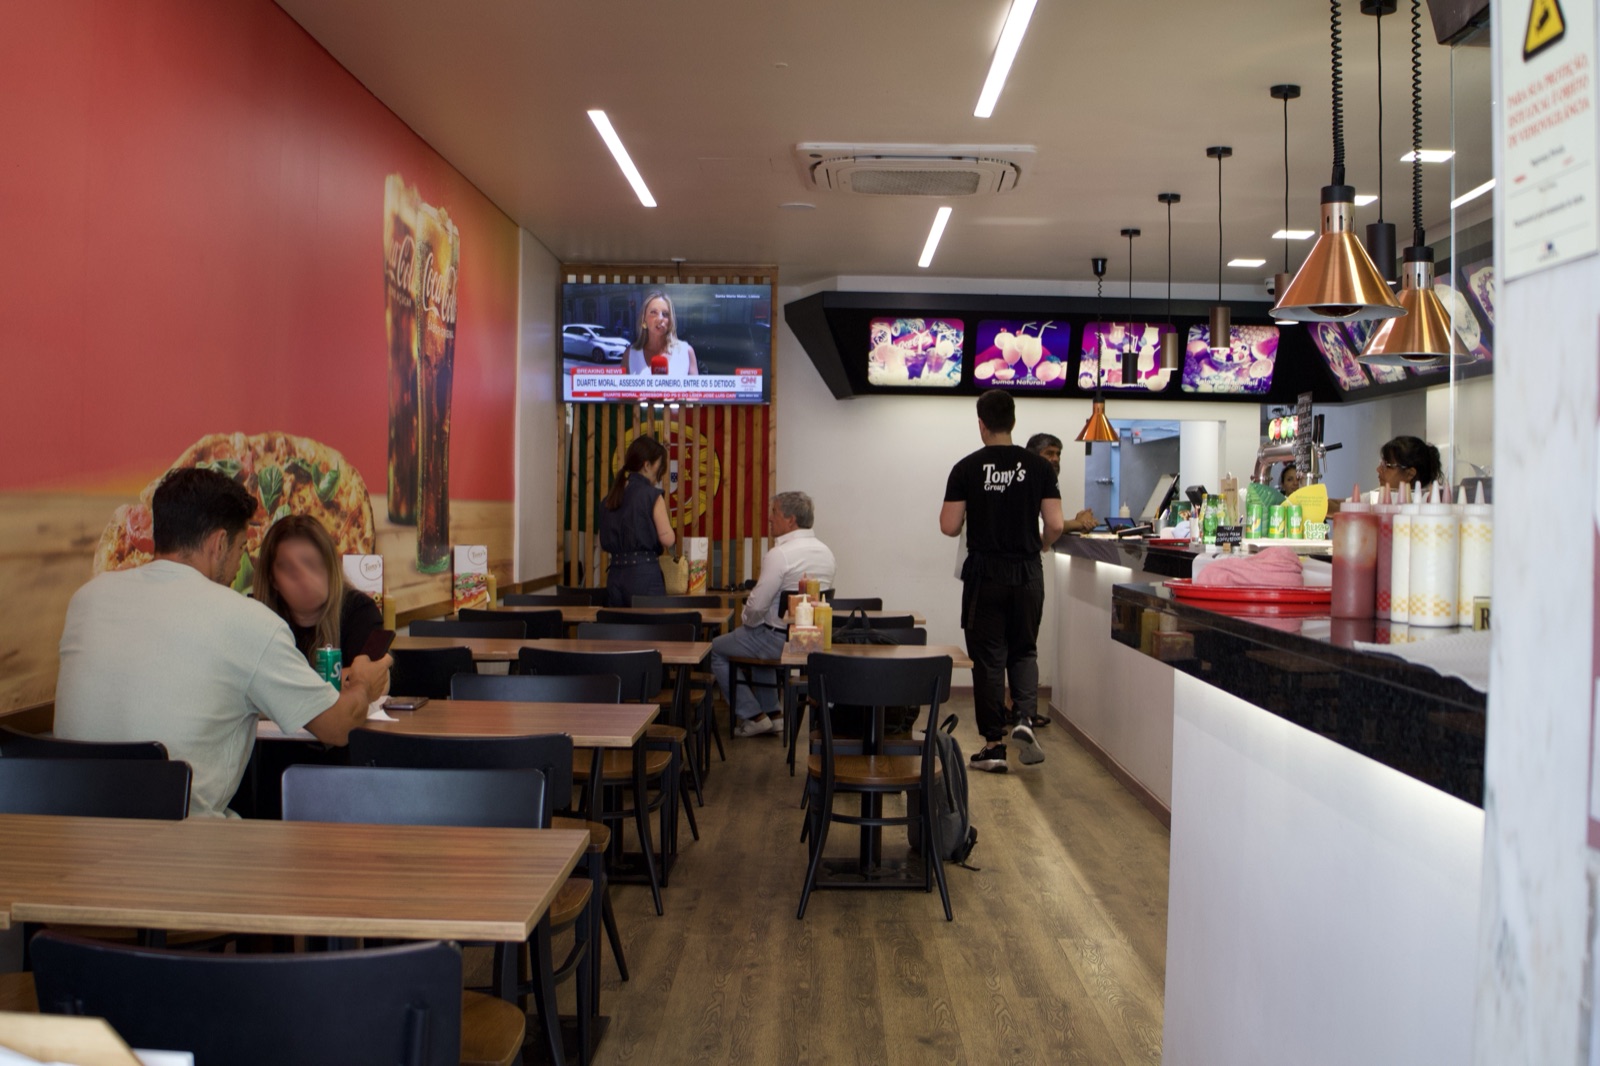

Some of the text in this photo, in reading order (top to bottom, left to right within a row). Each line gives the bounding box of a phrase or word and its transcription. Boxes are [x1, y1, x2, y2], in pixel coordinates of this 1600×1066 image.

[577, 379, 597, 387] DUARTE
[598, 379, 618, 388] MORAL,
[619, 379, 645, 387] ASSESSOR
[646, 379, 653, 387] DE
[654, 379, 682, 388] CARNEIRO,
[683, 379, 700, 388] ENTRE
[701, 379, 709, 388] OS
[714, 379, 736, 388] DETIDOS
[983, 462, 1026, 486] Tony's
[984, 483, 1006, 493] Group
